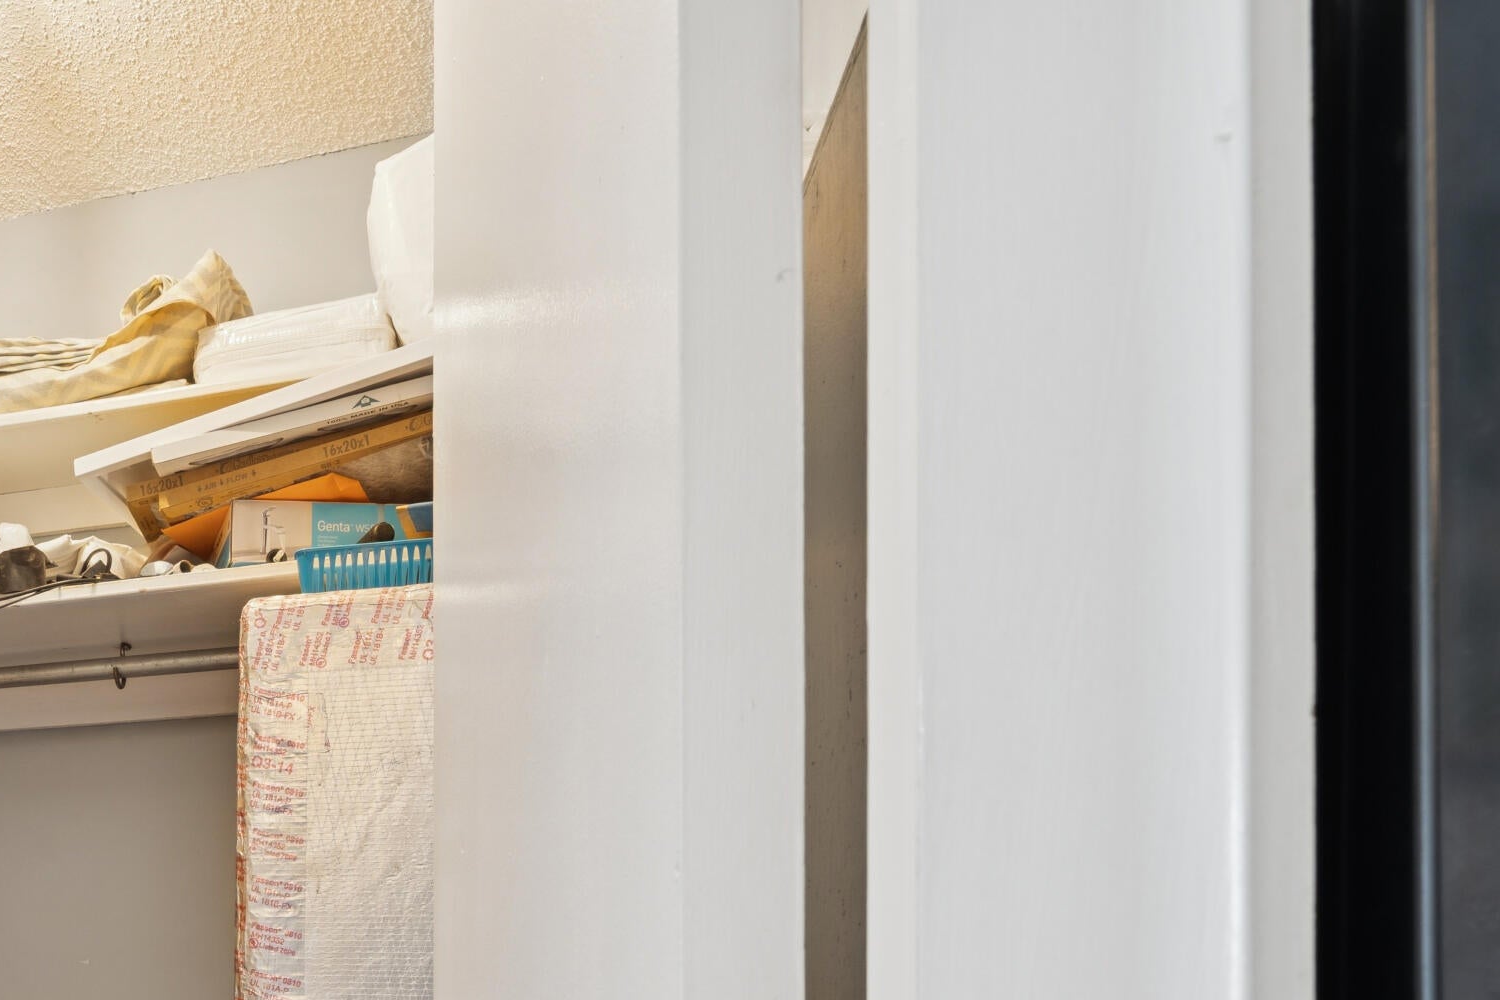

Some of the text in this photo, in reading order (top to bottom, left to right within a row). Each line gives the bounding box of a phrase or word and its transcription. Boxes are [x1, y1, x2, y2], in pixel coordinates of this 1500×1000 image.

[322, 434, 370, 458] 16x20x1
[140, 475, 184, 497] 16x20x1
[317, 520, 350, 533] Genta
